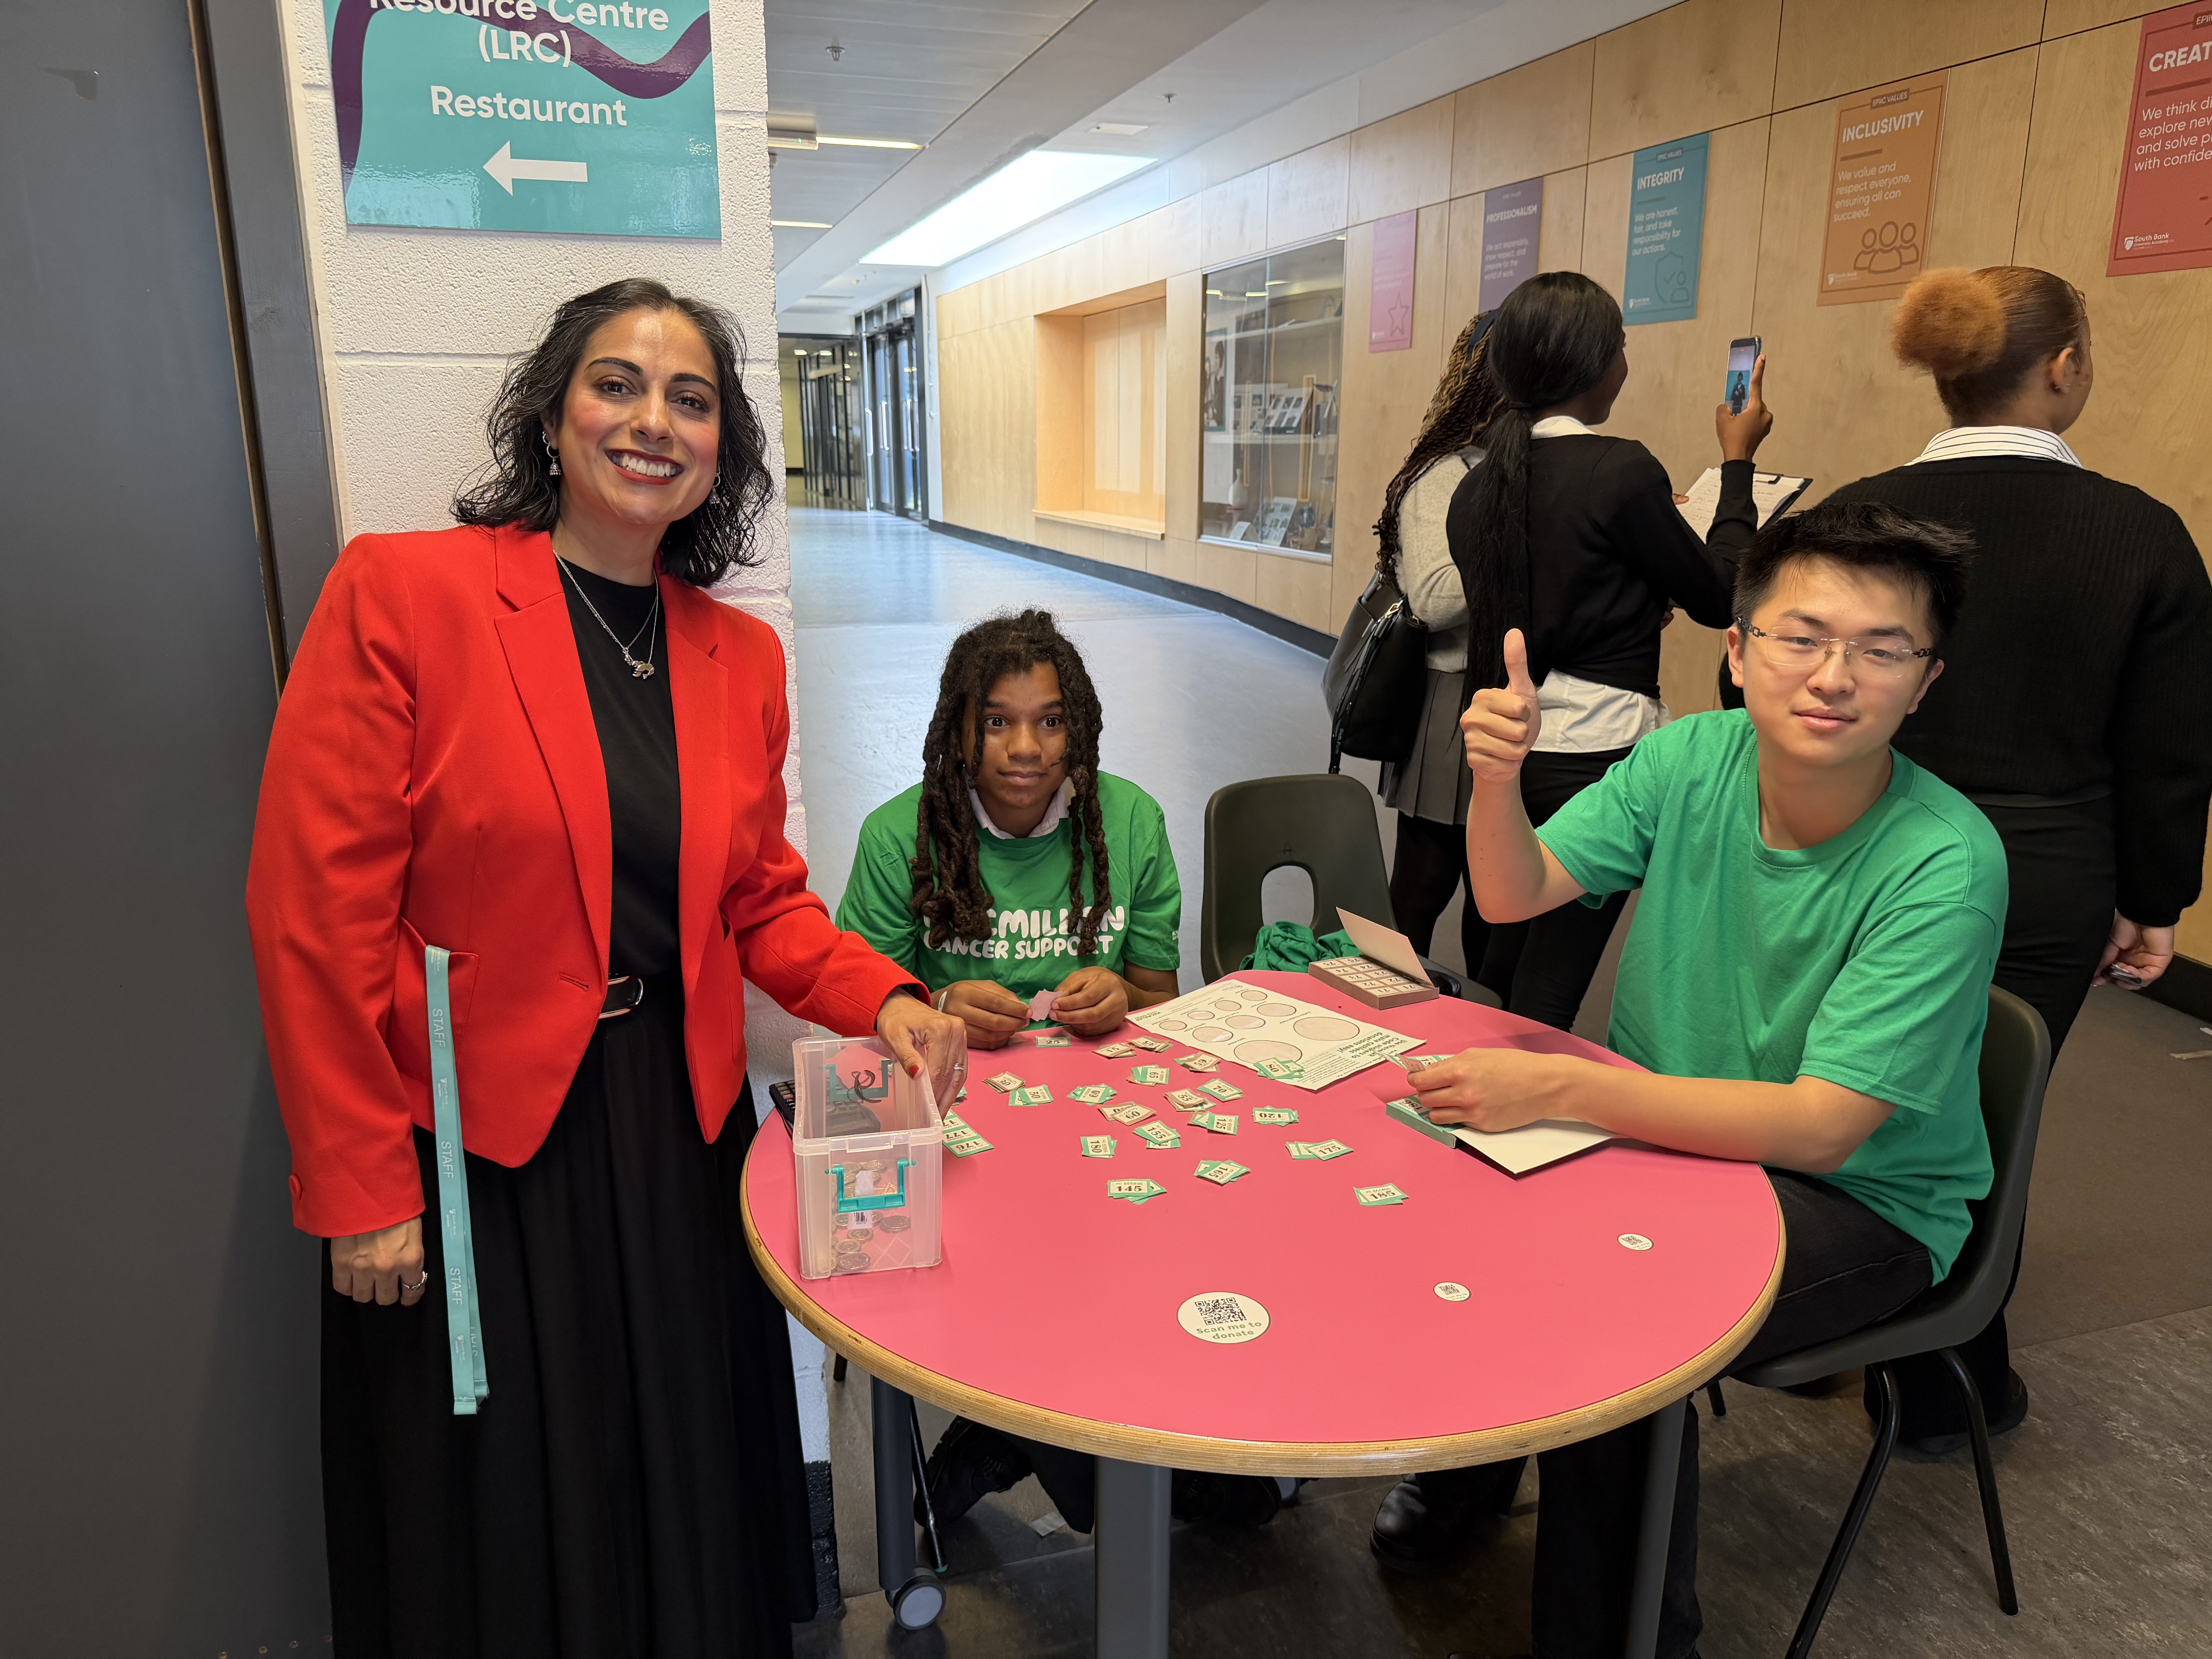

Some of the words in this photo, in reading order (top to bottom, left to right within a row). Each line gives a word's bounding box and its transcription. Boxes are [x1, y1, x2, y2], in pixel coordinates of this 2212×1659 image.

[548, 0, 669, 30] Centre
[479, 25, 571, 67] (LRC)
[431, 86, 627, 125] Restaurant
[1887, 92, 1908, 102] VALUES
[2142, 108, 2162, 121] We
[2166, 100, 2197, 116] think
[1843, 110, 1924, 143] INCLUSIVITY
[2139, 122, 2186, 139] explore
[2136, 139, 2162, 155] and
[2165, 135, 2198, 150] solve
[1838, 170, 1851, 181] We
[1853, 167, 1876, 178] value
[1879, 161, 1896, 173] and
[2135, 157, 2160, 172] with
[1637, 167, 1684, 191] INTEGRITY
[1836, 181, 1867, 195] respect
[1869, 174, 1911, 188] everyone,
[1835, 194, 1870, 208] ensuring
[1872, 190, 1882, 202] all
[1884, 189, 1901, 200] can
[1486, 204, 1537, 223] PROFESSIONALISM
[433, 1009, 445, 1047] STAFF
[1266, 1064, 1279, 1072] 80
[1147, 1127, 1166, 1139] 155
[1216, 1118, 1227, 1130] 125
[946, 1130, 968, 1139] 177
[956, 1141, 981, 1151] 176
[1091, 1140, 1102, 1153] 180
[1319, 1146, 1341, 1154] 175
[441, 1141, 454, 1179] STAFF
[1209, 1167, 1228, 1178] 165
[1370, 1190, 1396, 1199] 185
[450, 1267, 463, 1305] STAFF
[1212, 1330, 1254, 1340] donate
